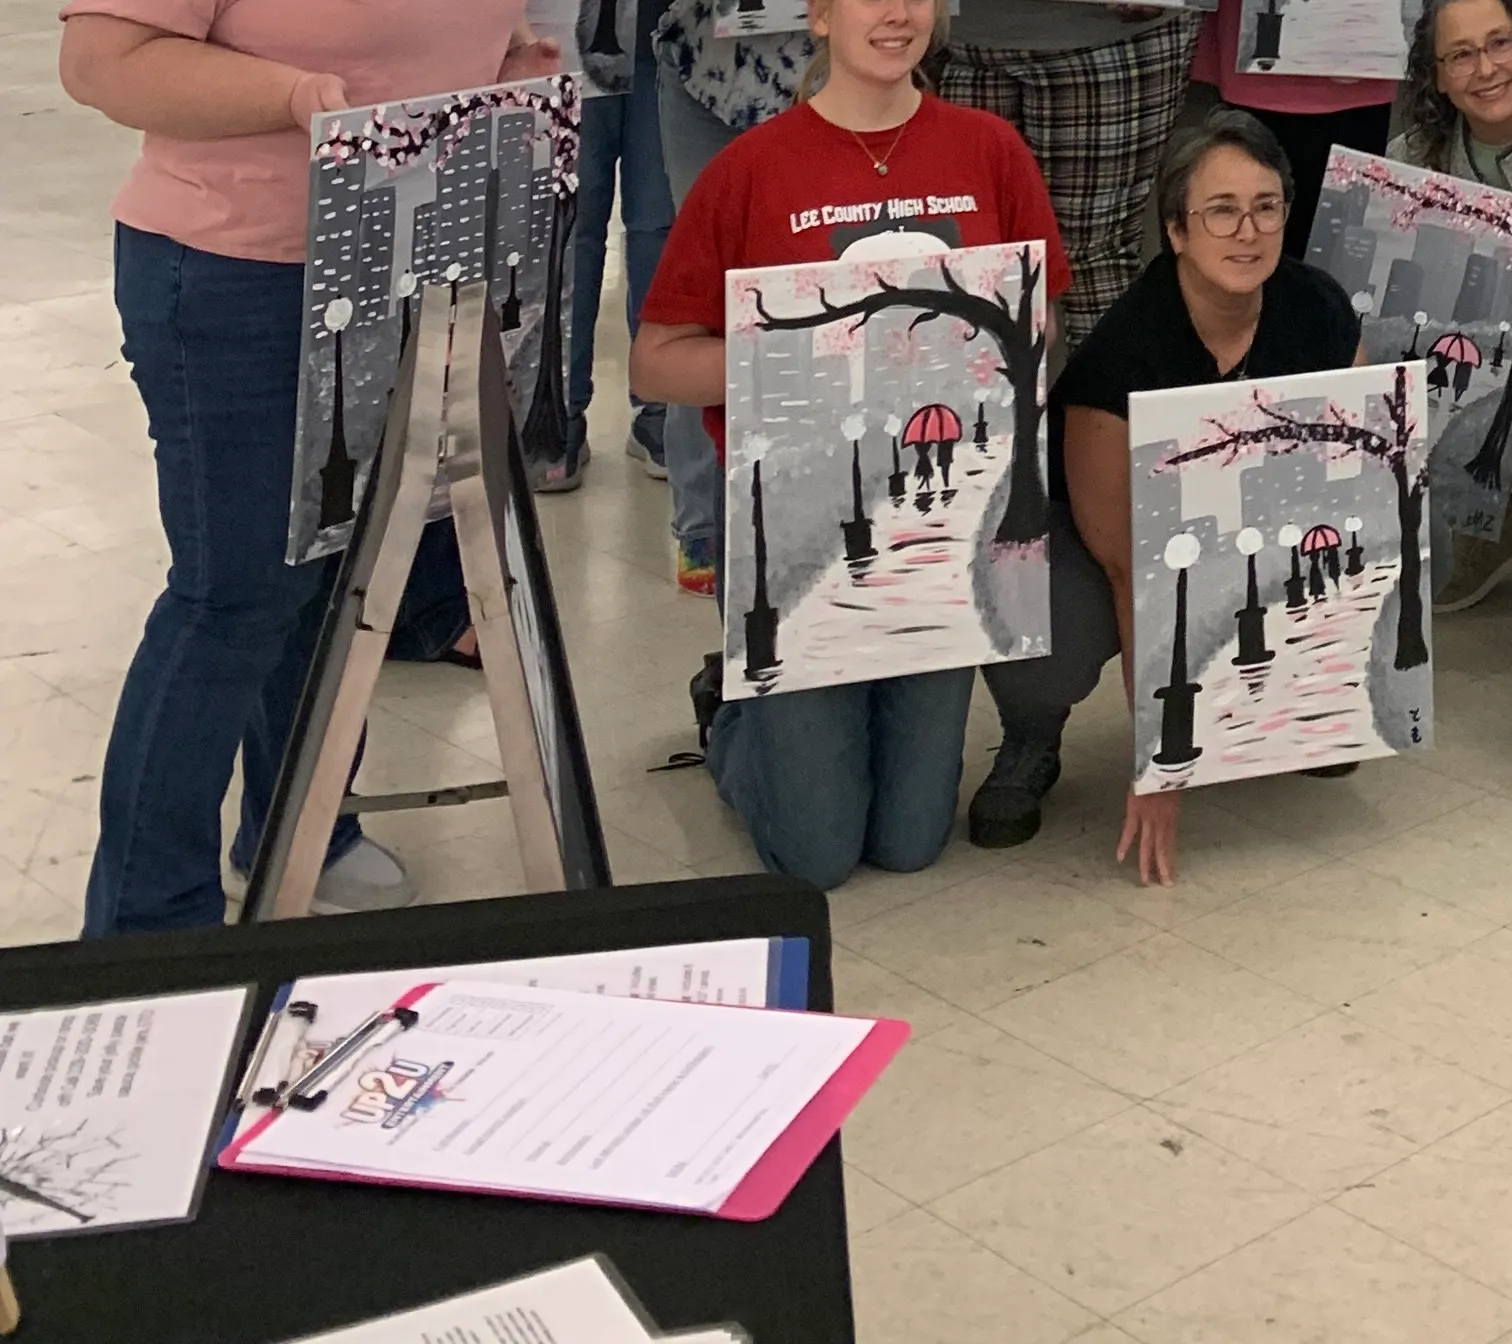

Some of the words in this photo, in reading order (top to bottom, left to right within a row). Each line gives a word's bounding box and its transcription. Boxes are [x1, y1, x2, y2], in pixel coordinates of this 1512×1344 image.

[789, 209, 821, 234] LEE
[821, 202, 883, 225] COUNTY
[887, 198, 925, 220] HIGH
[925, 195, 978, 216] SCHOOL
[339, 1058, 431, 1124] UP2U
